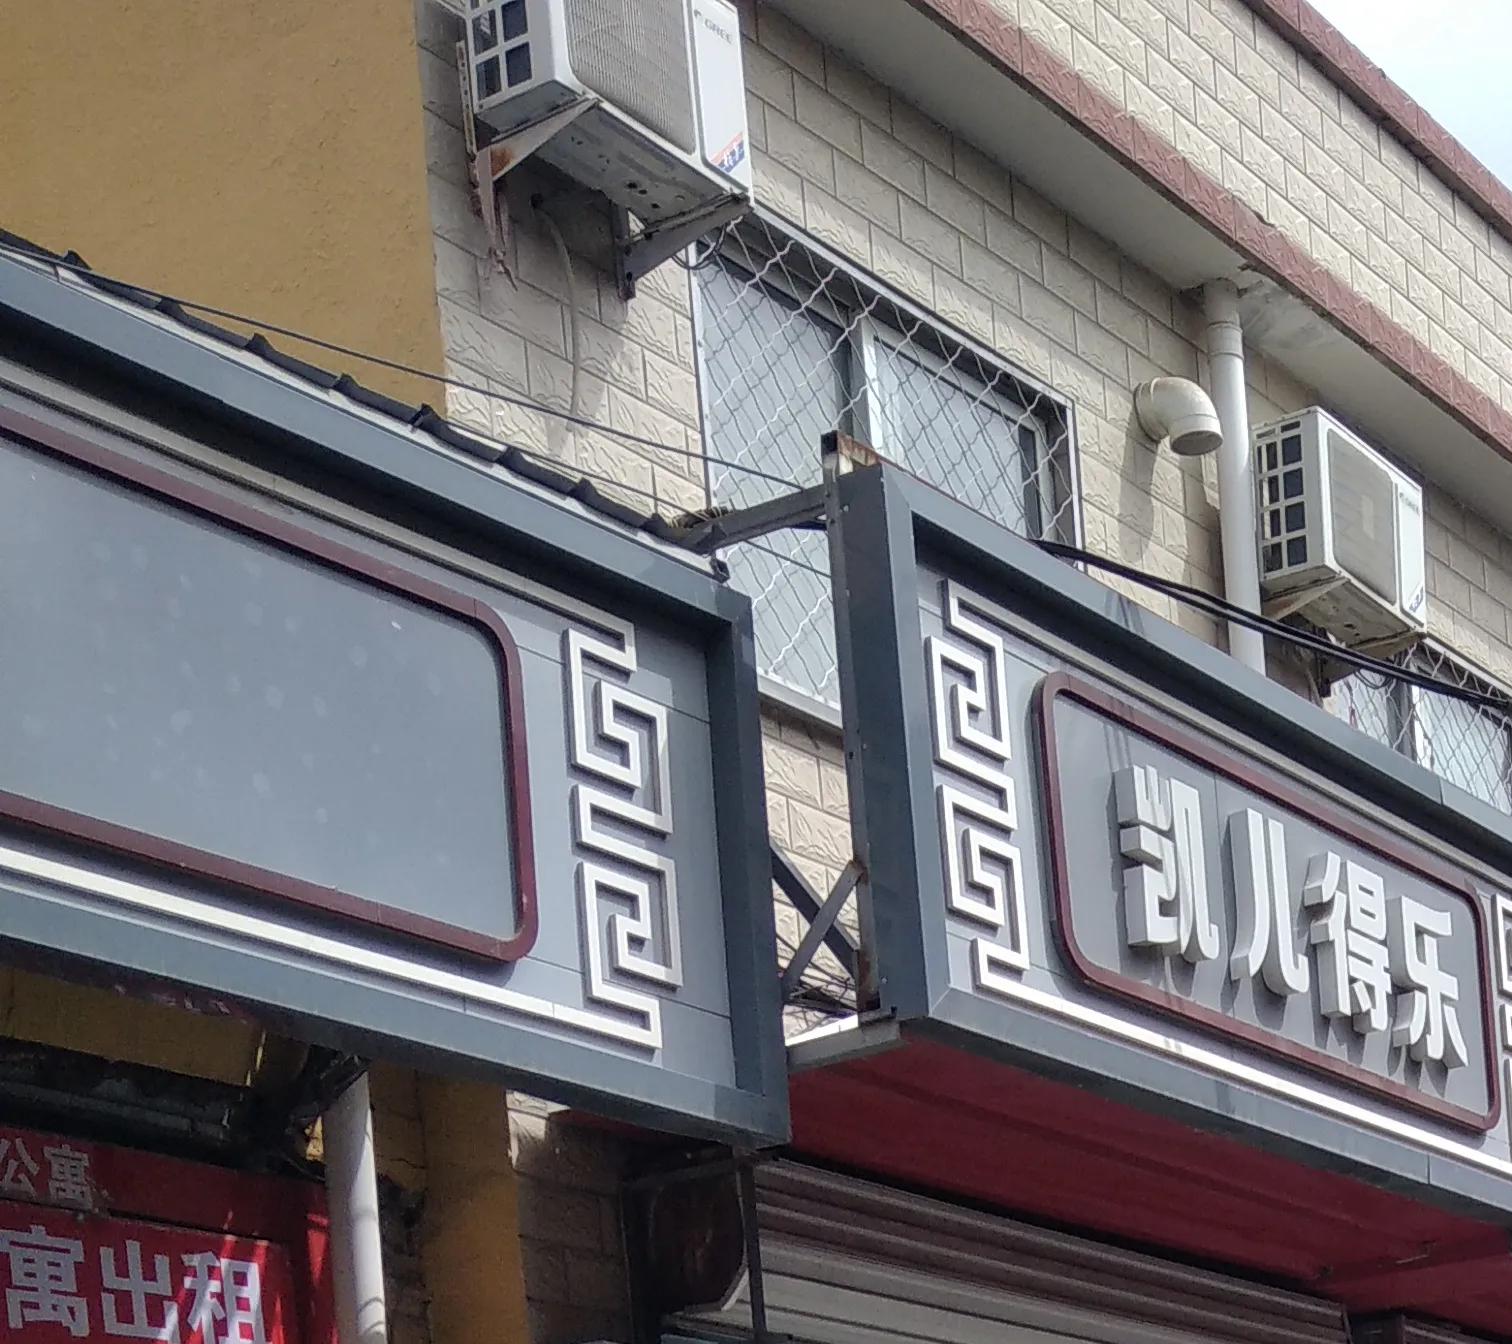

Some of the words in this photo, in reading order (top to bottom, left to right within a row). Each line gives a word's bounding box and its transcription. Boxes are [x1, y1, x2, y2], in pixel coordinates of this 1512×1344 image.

[1114, 765, 1469, 1069] 凯儿得乐
[0, 1138, 93, 1211] 公寓
